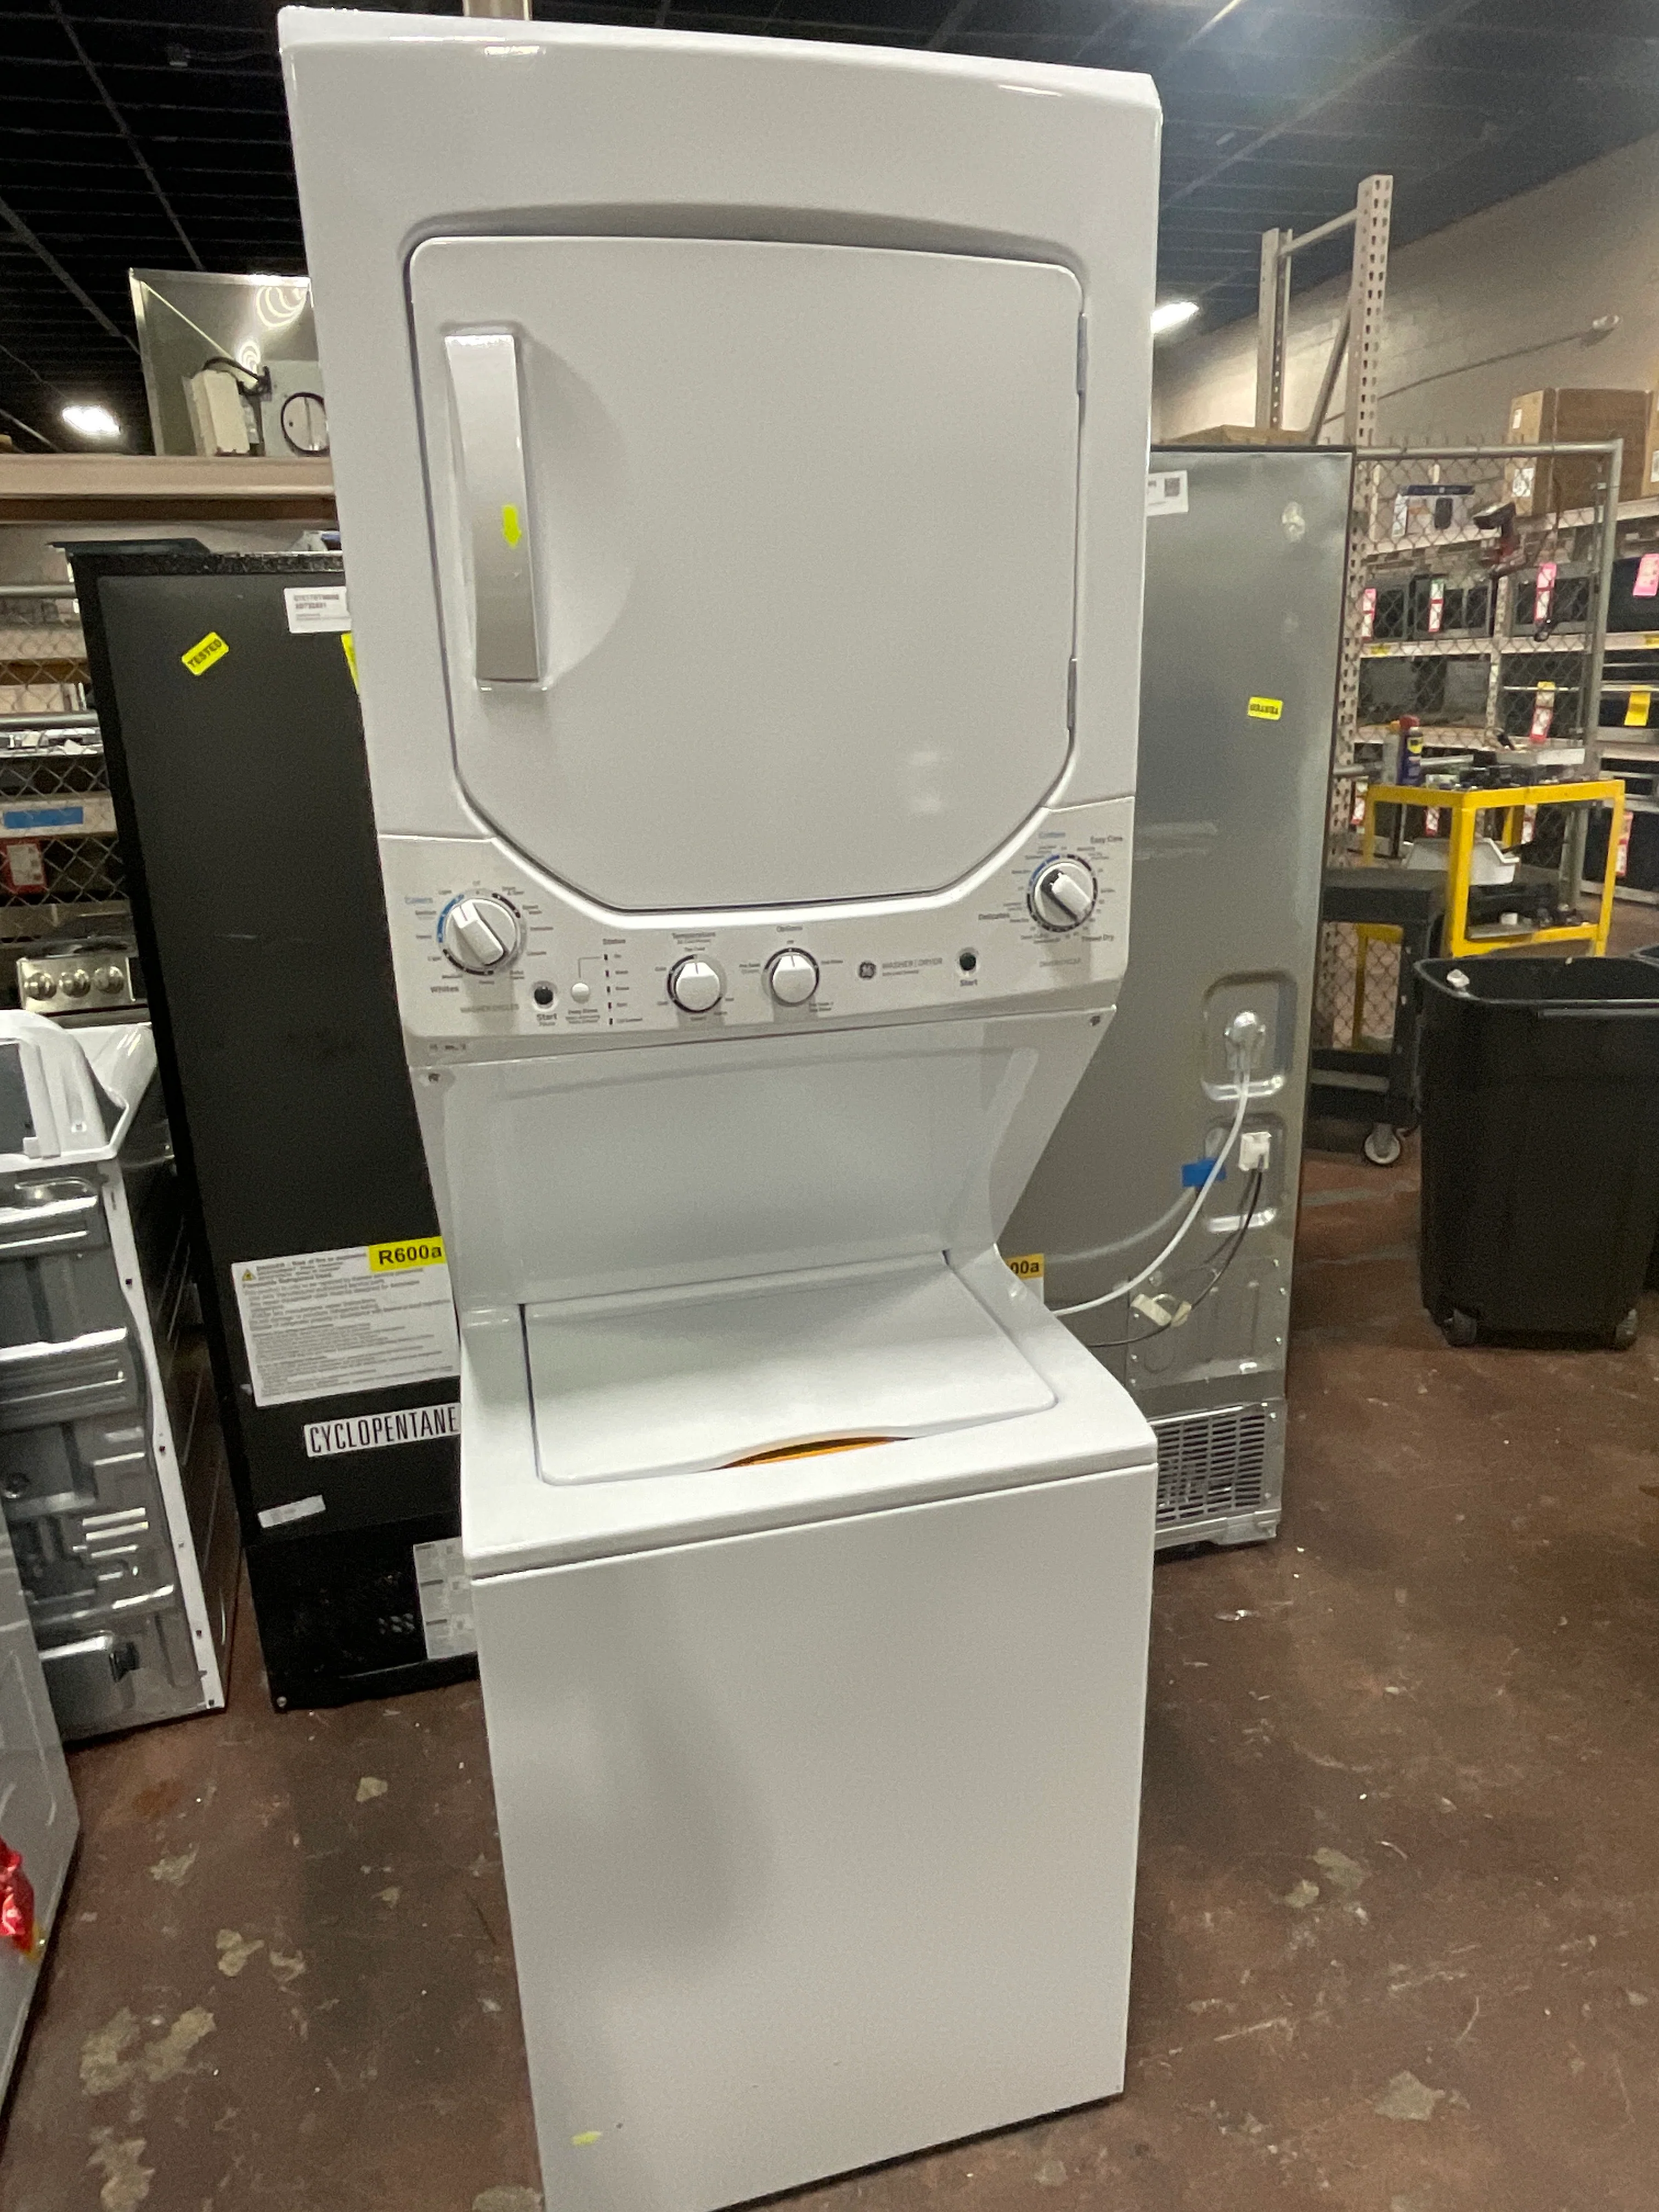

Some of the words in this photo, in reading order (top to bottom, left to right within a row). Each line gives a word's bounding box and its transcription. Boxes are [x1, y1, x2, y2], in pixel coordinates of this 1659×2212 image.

[187, 638, 222, 668] TESTED
[379, 1245, 442, 1265] R600a
[309, 1406, 460, 1453] CYCLOPENTANE
